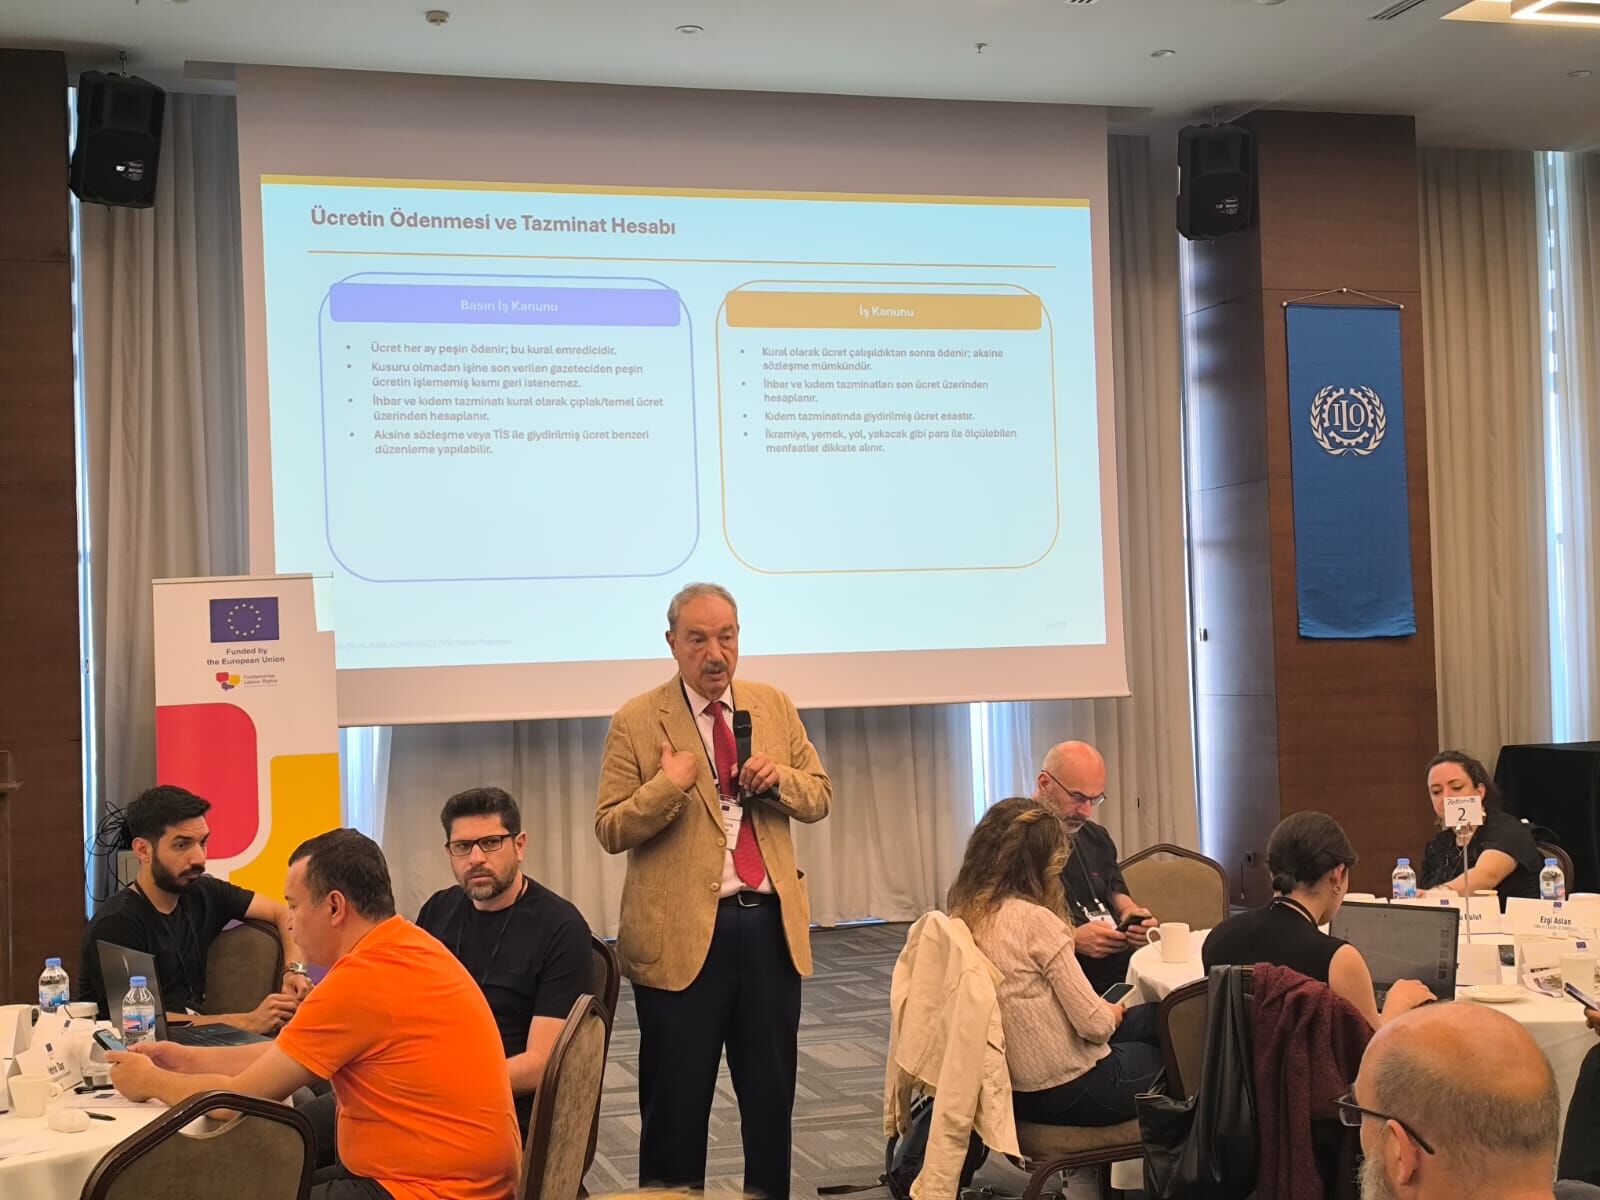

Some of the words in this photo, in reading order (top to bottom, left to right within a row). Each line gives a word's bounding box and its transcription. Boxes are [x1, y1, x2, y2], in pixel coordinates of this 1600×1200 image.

[310, 204, 384, 227] Ücretin
[389, 207, 490, 229] Ödenmesi
[494, 217, 517, 230] ve
[520, 214, 607, 232] Tazminat
[611, 217, 676, 234] Hesabı
[497, 296, 509, 313] İş
[510, 298, 558, 312] Kanunu
[859, 303, 870, 319] İş
[871, 304, 914, 317] Kanunu
[370, 339, 402, 352] Ücret
[403, 342, 422, 352] her
[423, 344, 437, 355] ay
[438, 342, 469, 355] peşin
[469, 342, 509, 355] ödenir;
[510, 343, 525, 353] bu
[527, 343, 554, 354] kural
[555, 343, 617, 354] emredicidir.
[762, 346, 788, 356] Kural
[788, 346, 820, 356] olarak
[821, 346, 848, 356] ücret
[908, 348, 936, 357] sonra
[937, 347, 971, 358] ödenir;
[972, 347, 1003, 357] aksine
[371, 361, 410, 372] Kusuru
[411, 361, 461, 372] olmadan
[462, 362, 489, 374] işine
[490, 364, 511, 372] son
[511, 362, 548, 372] verilen
[549, 362, 613, 375] gazeteciden
[614, 363, 643, 376] peşin
[763, 359, 810, 372] sözleşme
[371, 376, 411, 386] ücretin
[502, 376, 522, 389] geri
[523, 377, 581, 387] istenemez.
[763, 376, 790, 388] İhbar
[789, 380, 803, 388] ve
[803, 378, 835, 388] kıdem
[895, 380, 914, 388] son
[915, 378, 941, 389] ücret
[941, 378, 988, 389] üzerinden
[372, 393, 402, 405] İhbar
[403, 397, 417, 405] ve
[418, 395, 452, 405] kıdem
[454, 395, 505, 406] tazminatı
[506, 395, 534, 406] kural
[534, 395, 568, 406] olarak
[636, 396, 664, 406] ücret
[763, 391, 818, 404] hesaplanır.
[373, 410, 428, 420] üzerinden
[429, 410, 490, 423] hesaplanır.
[764, 410, 796, 420] Kıdem
[913, 410, 940, 420] ücret
[940, 410, 975, 420] esastır.
[1332, 399, 1365, 433] ILO
[373, 429, 411, 439] Aksine
[413, 429, 465, 442] sözleşme
[466, 431, 491, 442] veya
[492, 426, 510, 439] TİS
[511, 429, 525, 439] ile
[582, 429, 610, 439] ücret
[611, 429, 649, 439] benzeri
[867, 427, 908, 440] yakacak
[908, 427, 926, 440] gibi
[927, 429, 949, 440] para
[951, 427, 963, 438] ile
[374, 443, 436, 454] düzenleme
[436, 443, 493, 456] yapılabilir.
[765, 442, 820, 452] menfaatler
[820, 441, 857, 452] dikkate
[858, 441, 885, 452] alınır.
[226, 647, 256, 655] Funded
[258, 647, 267, 655] by
[207, 658, 220, 666] the
[221, 657, 259, 665] European
[1457, 807, 1467, 821] 2
